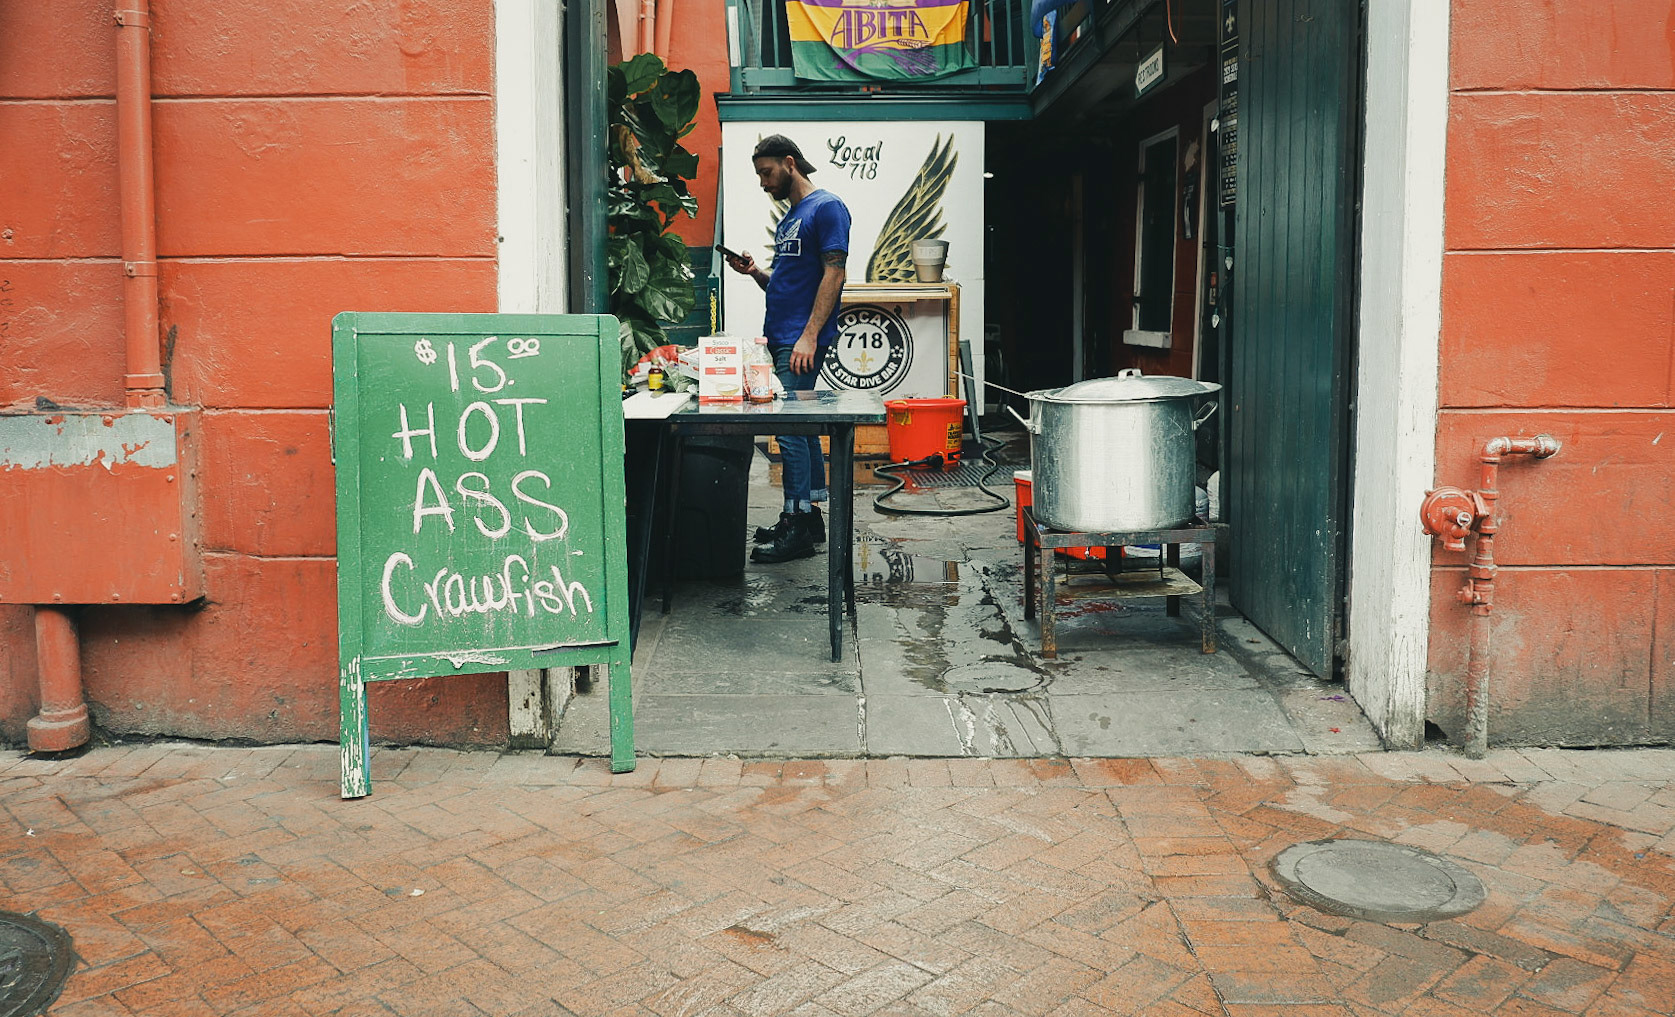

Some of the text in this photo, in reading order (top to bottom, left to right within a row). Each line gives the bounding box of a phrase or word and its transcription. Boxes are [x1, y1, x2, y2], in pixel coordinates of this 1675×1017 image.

[830, 9, 929, 50] ABITA
[827, 135, 883, 169] Local
[849, 162, 878, 181] 718
[837, 312, 890, 333] LOCAL
[844, 331, 883, 349] 718
[830, 361, 898, 387] 5 STAR DIVE BAR
[392, 397, 548, 462] HOT
[412, 467, 569, 540] ASS
[380, 551, 594, 627] Crawfish
